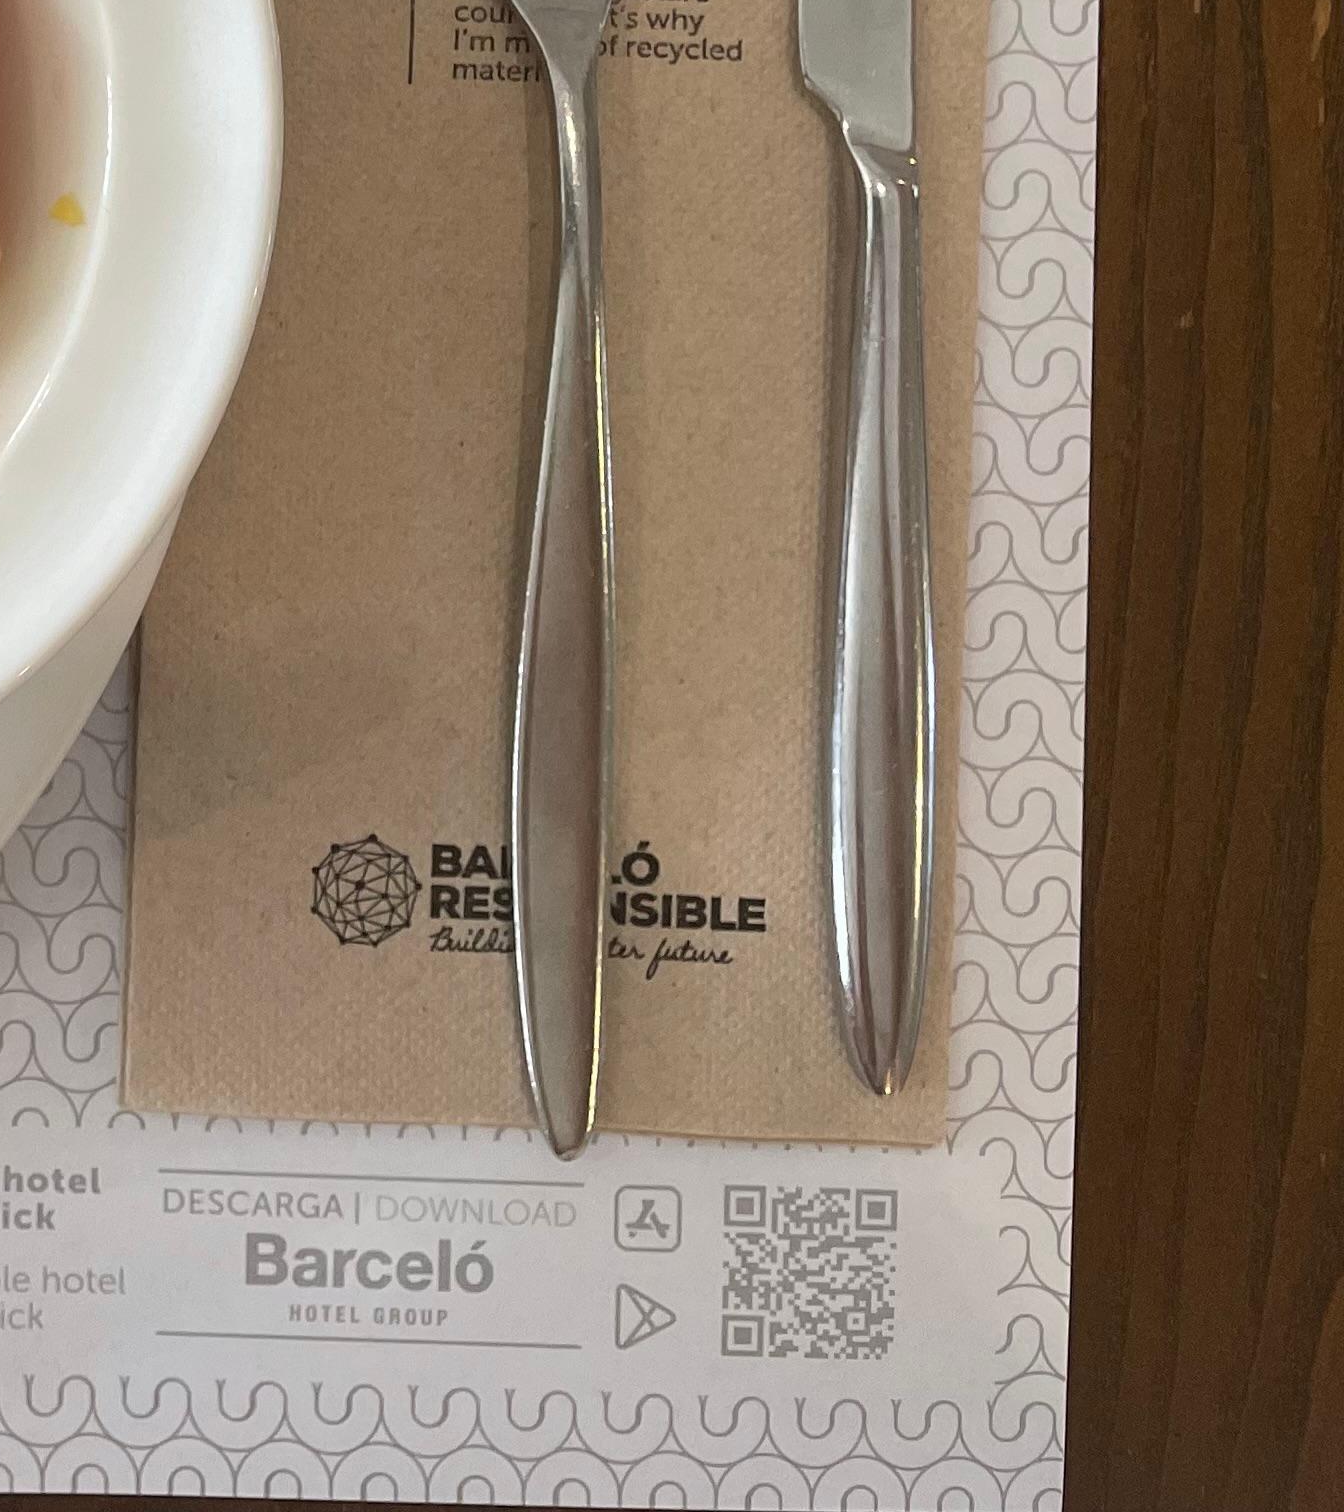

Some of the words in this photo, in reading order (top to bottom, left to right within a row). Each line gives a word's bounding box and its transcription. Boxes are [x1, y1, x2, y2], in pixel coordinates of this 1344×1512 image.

[646, 9, 704, 36] why
[454, 28, 495, 52] I'm
[626, 38, 743, 65] recycled
[430, 885, 766, 932] RESNSIBLE
[646, 937, 734, 980] future
[4, 1165, 100, 1194] hotel
[164, 1188, 343, 1218] DESCARGA
[377, 1195, 577, 1227] DOWNLOAD
[43, 1267, 124, 1294] hotel
[246, 1233, 493, 1293] Barceló
[290, 1305, 359, 1323] HOTEL
[374, 1308, 447, 1325] GROUP
